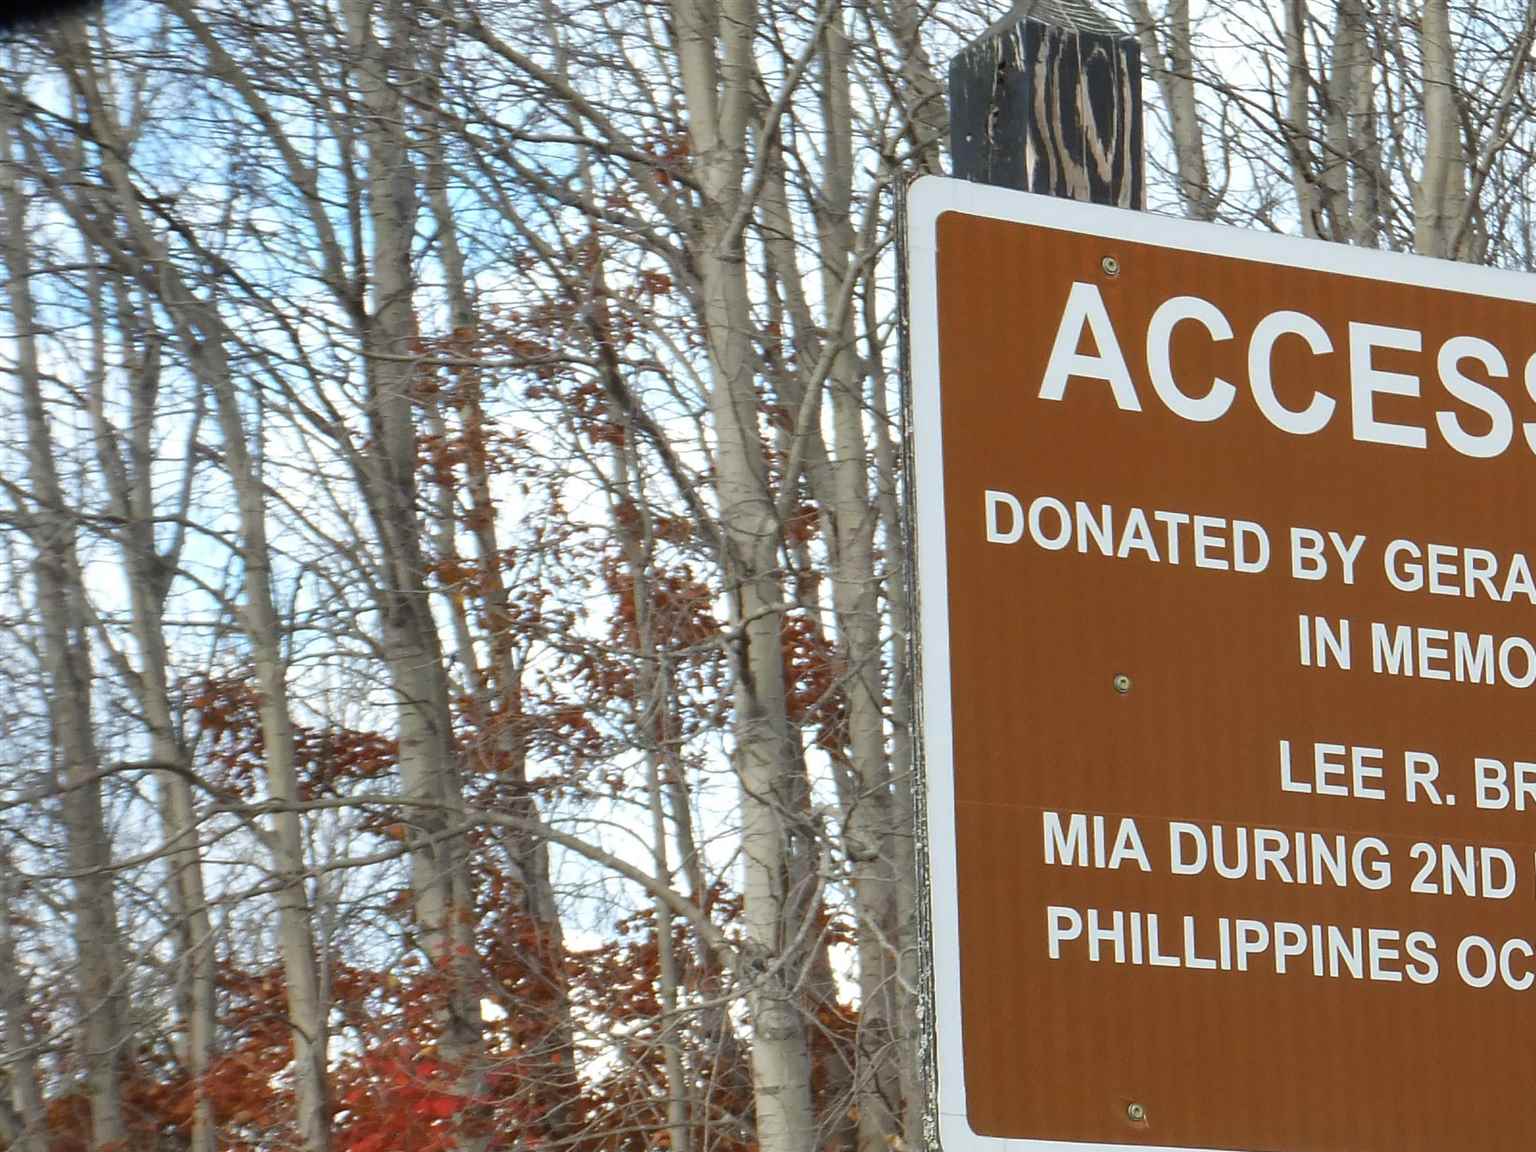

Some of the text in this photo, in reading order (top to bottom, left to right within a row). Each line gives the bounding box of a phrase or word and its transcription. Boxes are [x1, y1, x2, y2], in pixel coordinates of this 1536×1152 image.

[985, 490, 1270, 573] DONATED
[1291, 528, 1365, 584] BY
[1299, 615, 1350, 669] IN
[1280, 741, 1385, 799] LEE
[1405, 752, 1456, 806] R.
[1043, 812, 1151, 871] MIA
[1170, 822, 1391, 889] DURING
[1410, 843, 1515, 898] 2ND
[1048, 906, 1438, 983] PHILLIPPINES
